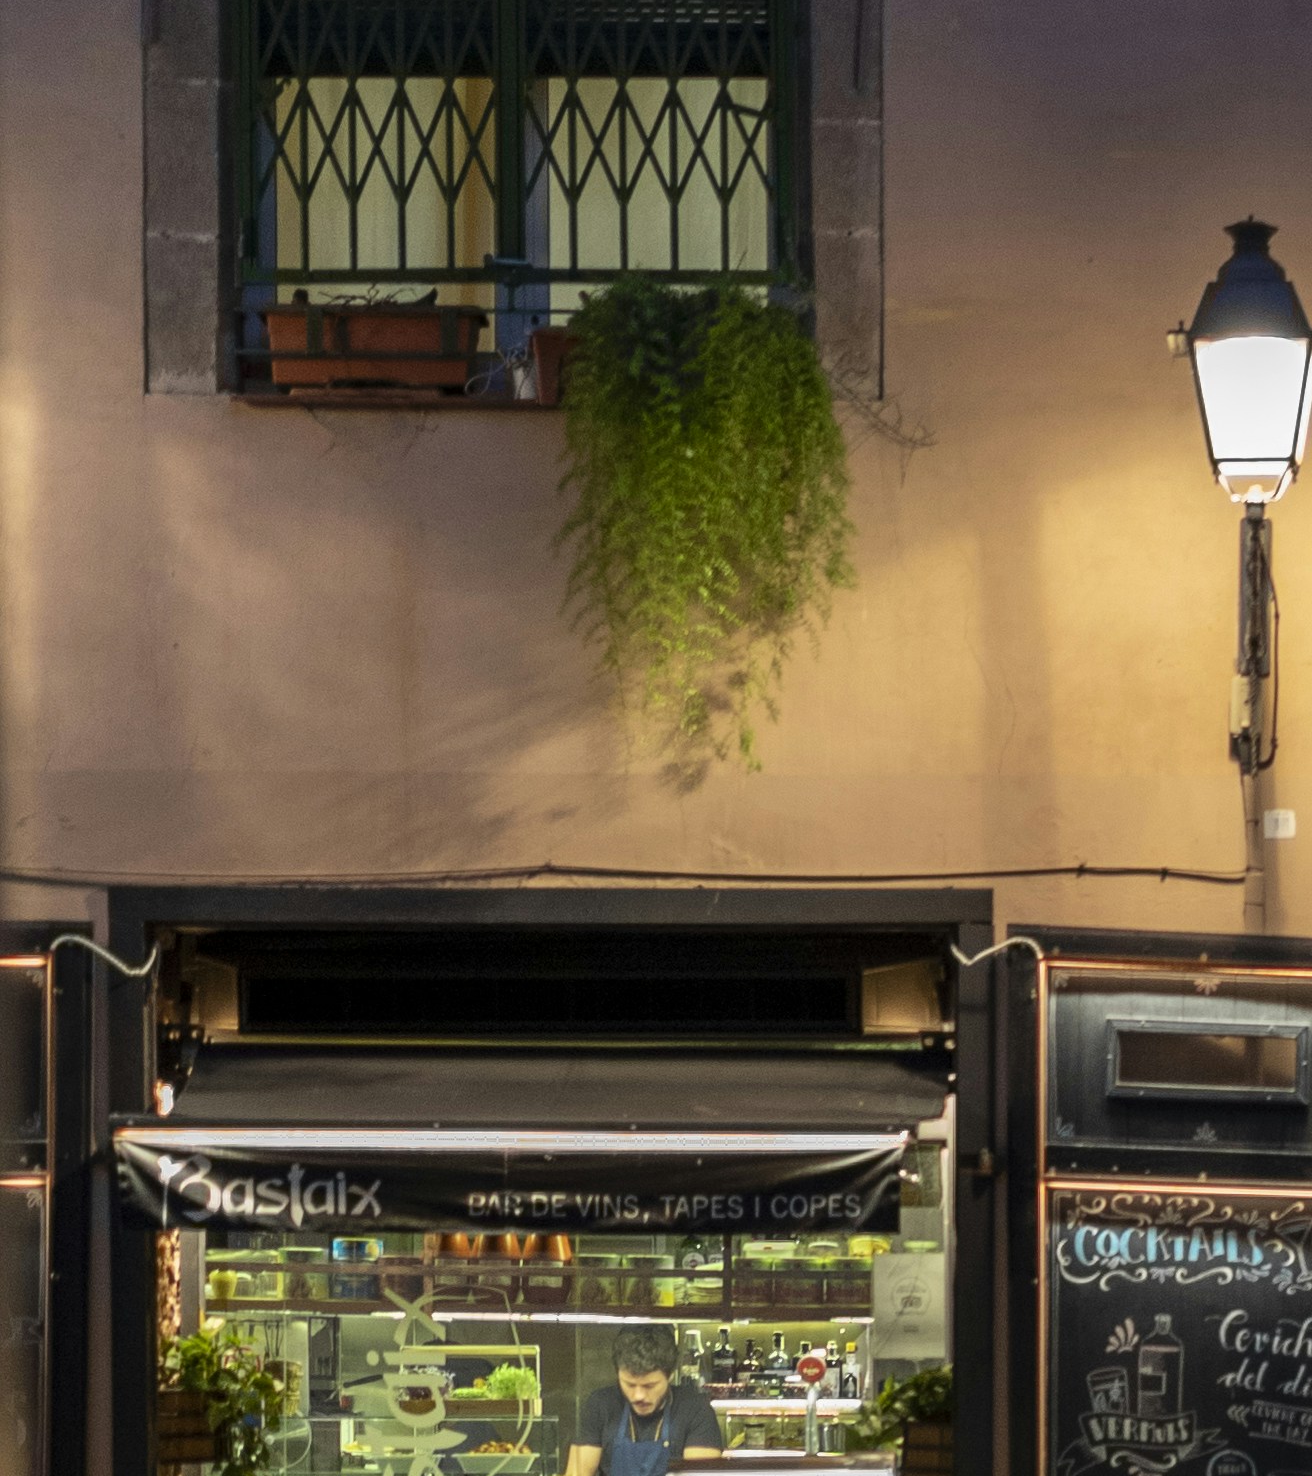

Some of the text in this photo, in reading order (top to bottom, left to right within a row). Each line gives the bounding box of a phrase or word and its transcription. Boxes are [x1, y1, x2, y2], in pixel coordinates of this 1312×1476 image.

[157, 1153, 382, 1228] Bastaix
[467, 1192, 523, 1218] BAR
[530, 1194, 567, 1218] DE
[574, 1193, 651, 1224] VINS,
[660, 1194, 744, 1220] TAPES
[769, 1192, 862, 1219] COPES
[1074, 1224, 1264, 1267] COCKTAILS
[1217, 1357, 1269, 1392] del
